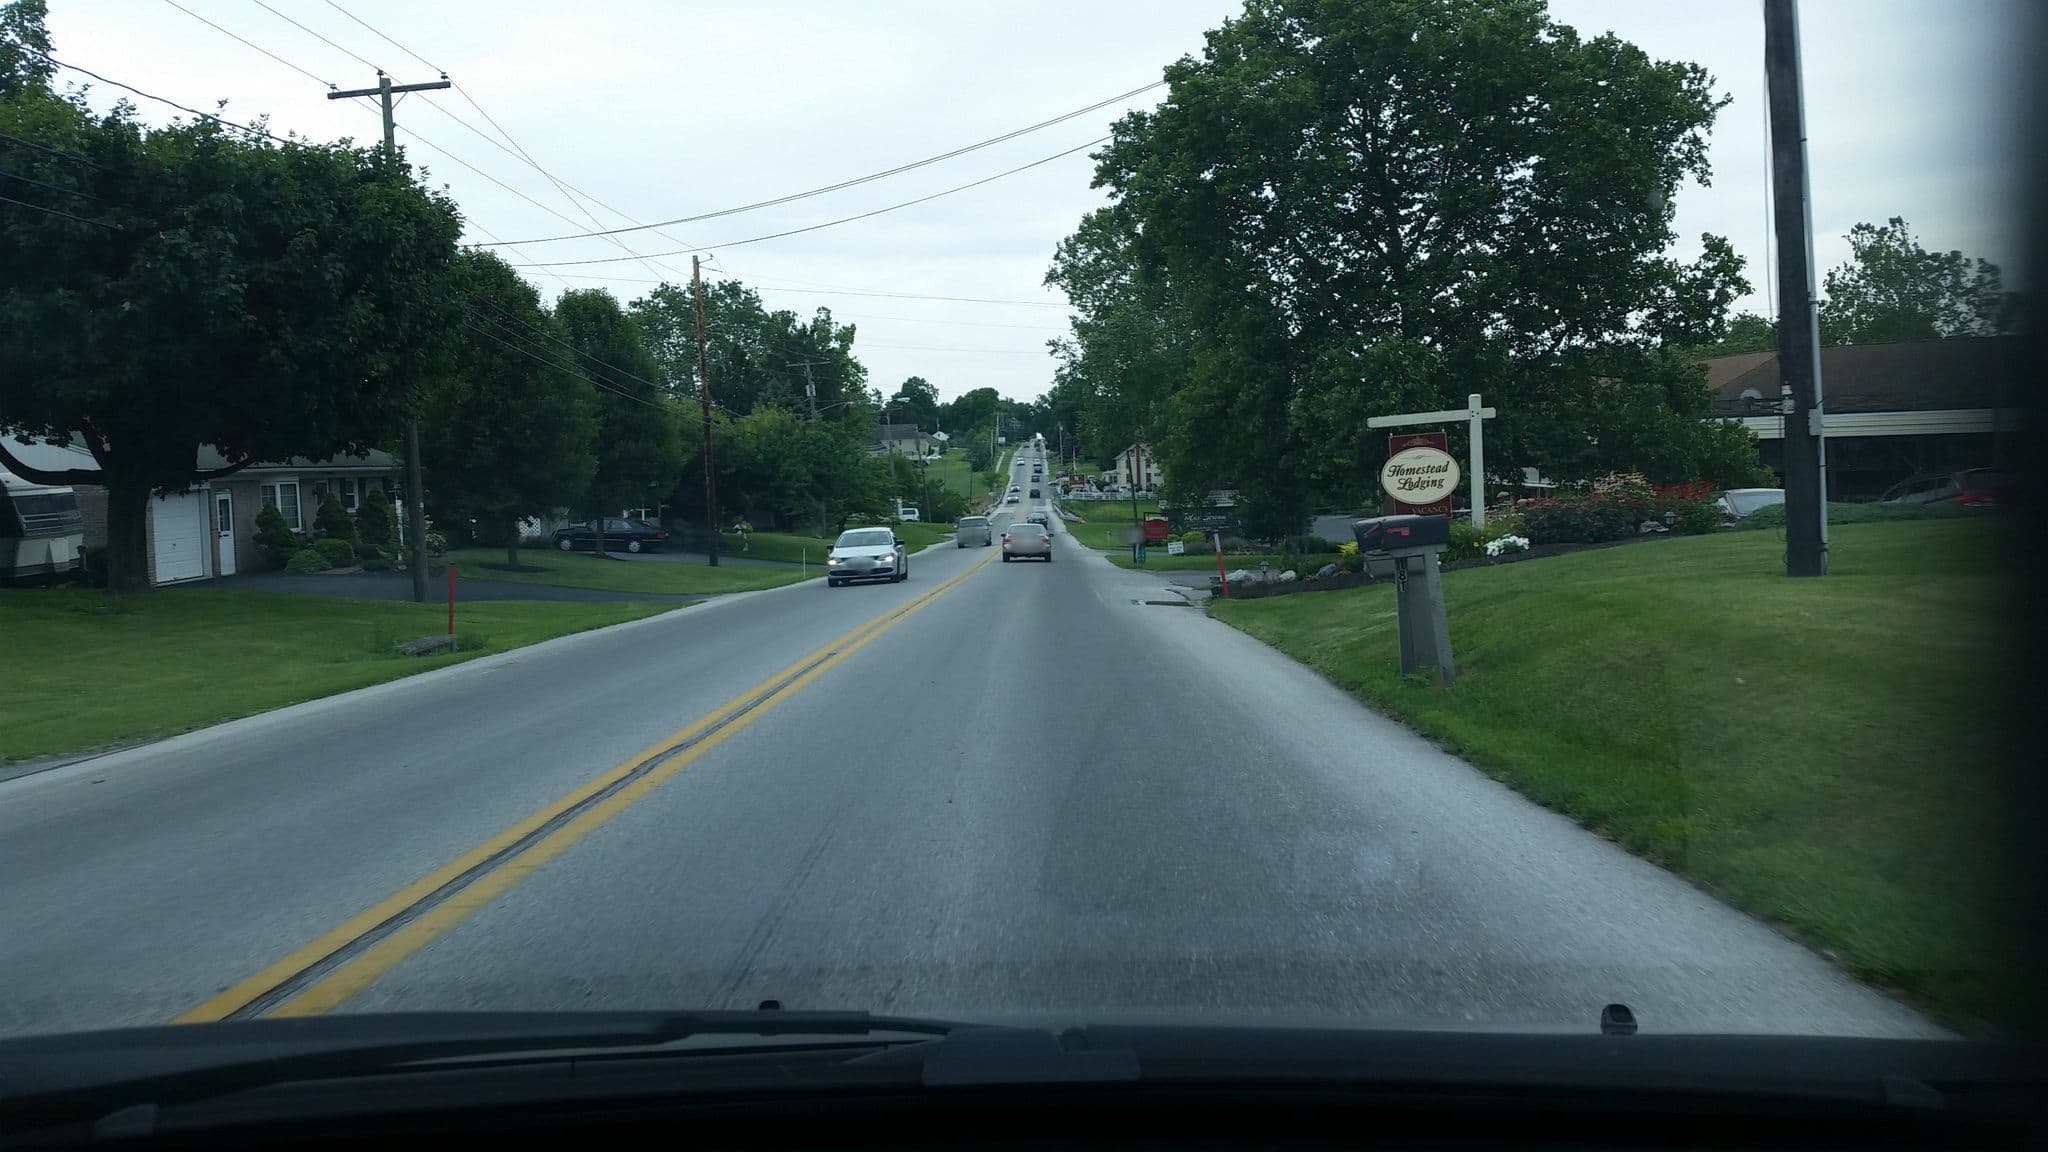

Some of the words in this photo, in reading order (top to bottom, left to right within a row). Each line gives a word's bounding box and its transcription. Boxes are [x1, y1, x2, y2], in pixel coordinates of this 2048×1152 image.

[1387, 461, 1450, 477] Homestead
[1397, 477, 1445, 491] Lodging
[1411, 506, 1448, 514] VACANCY
